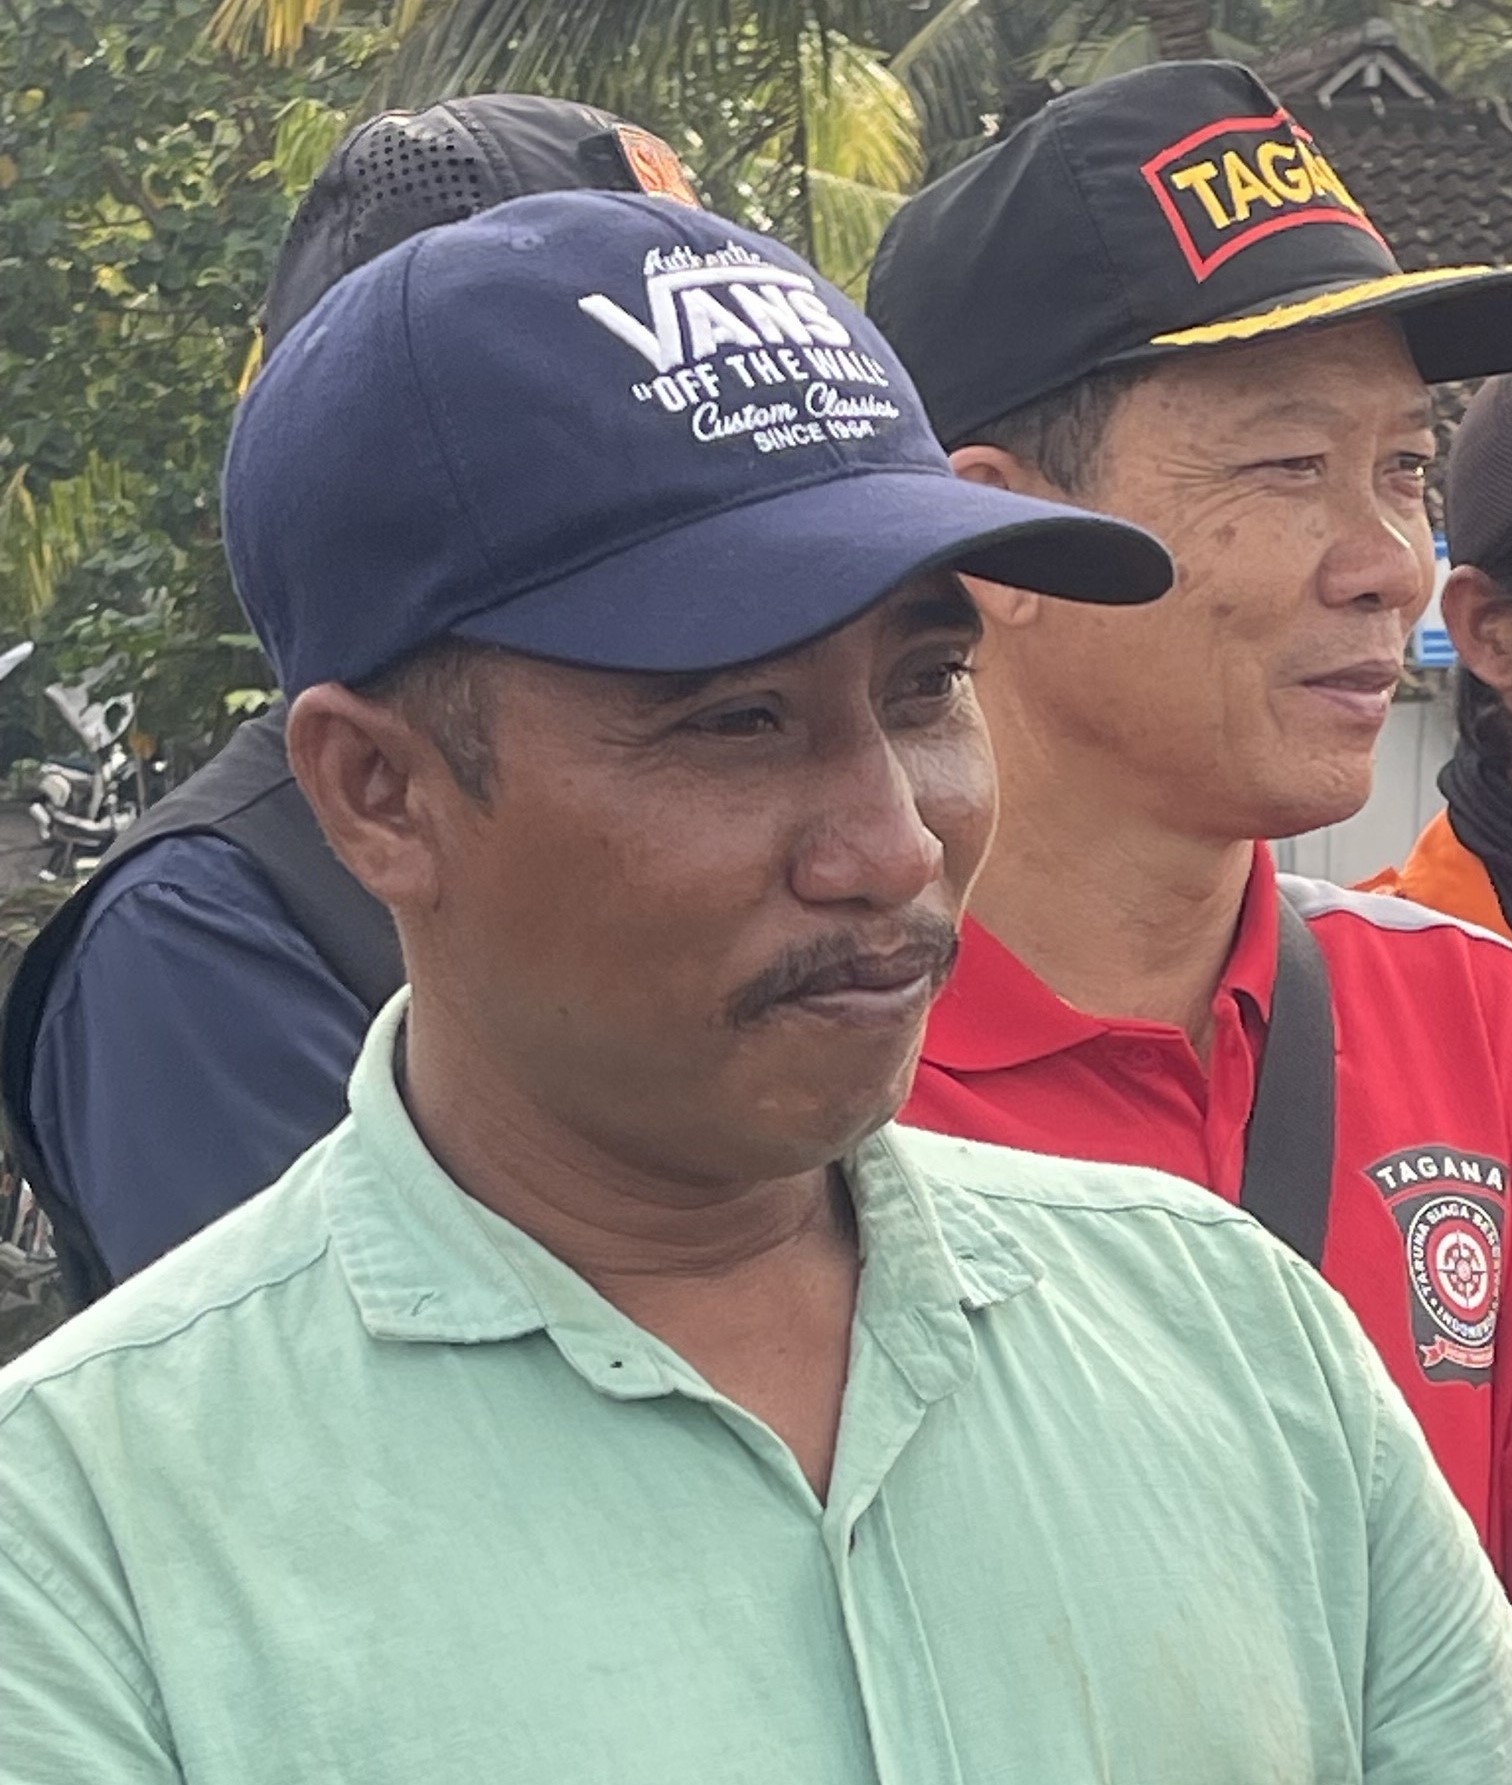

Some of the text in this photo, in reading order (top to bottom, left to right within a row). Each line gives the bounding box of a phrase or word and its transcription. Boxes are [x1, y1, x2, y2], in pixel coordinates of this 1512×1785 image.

[578, 265, 851, 374] VANS
[725, 348, 808, 388] THE
[692, 381, 900, 442] Custom Classics
[752, 421, 828, 453] SINCE
[1376, 1156, 1504, 1191] TAGANA
[1413, 1222, 1431, 1297] TARUNA
[1425, 1203, 1470, 1225] SIAGA
